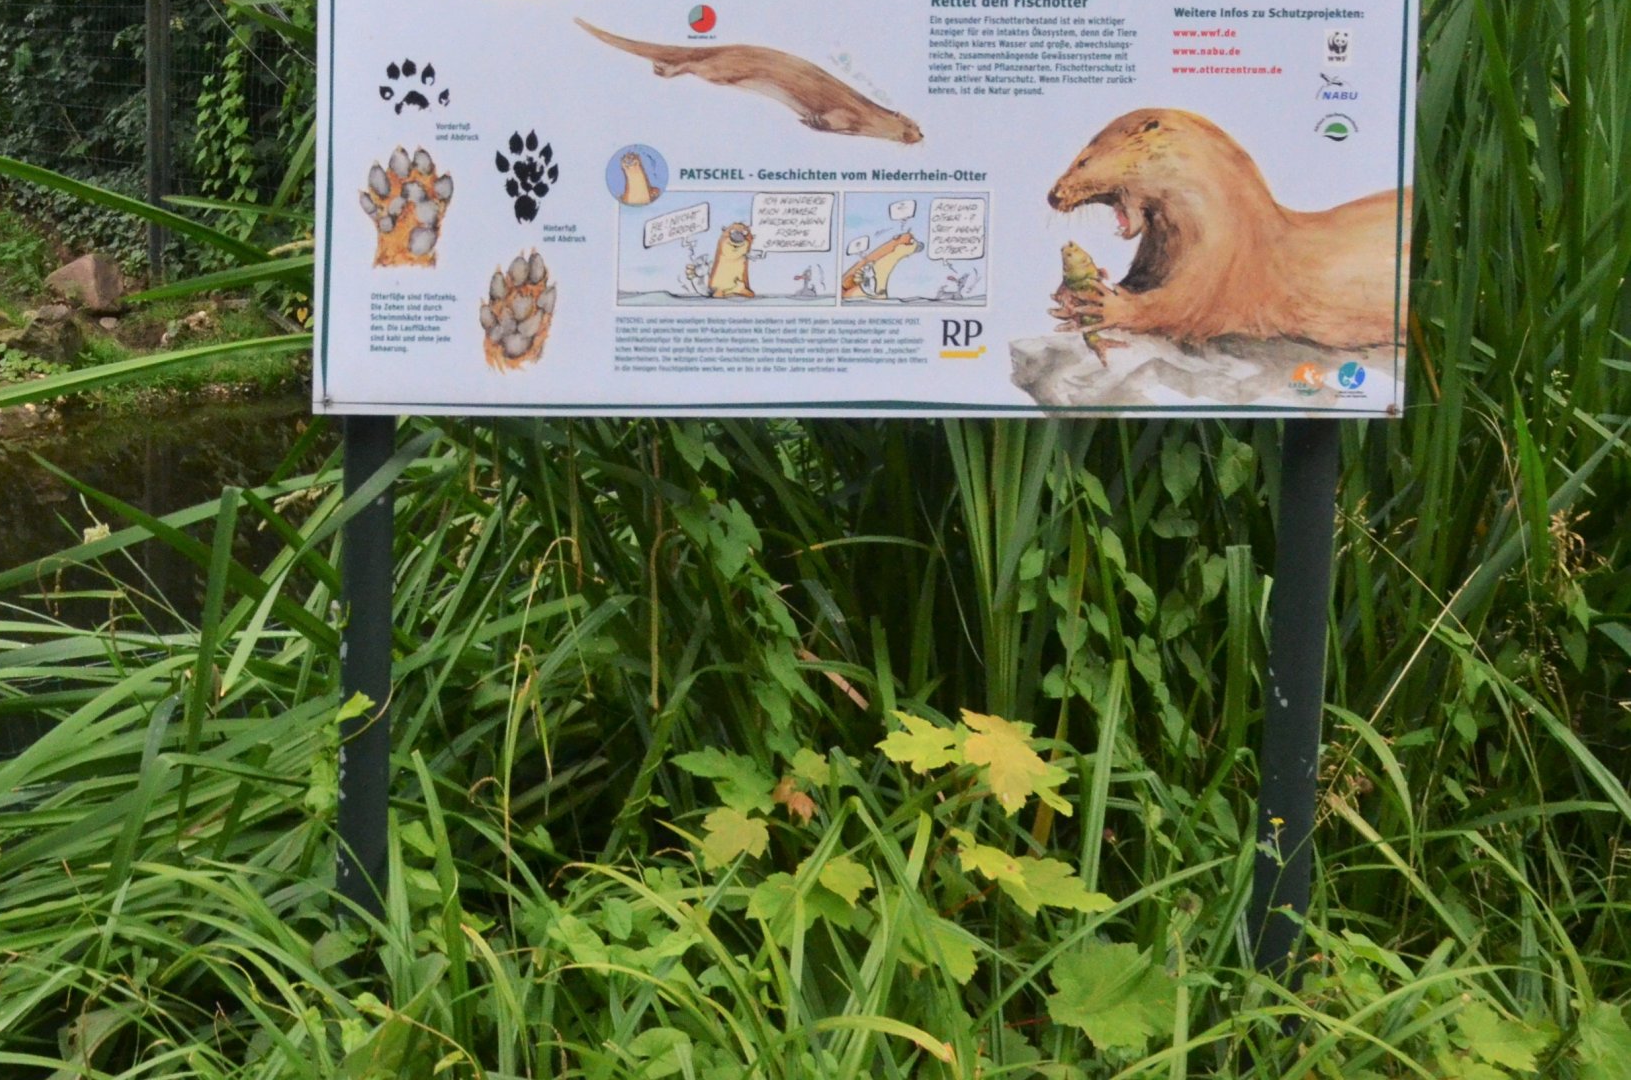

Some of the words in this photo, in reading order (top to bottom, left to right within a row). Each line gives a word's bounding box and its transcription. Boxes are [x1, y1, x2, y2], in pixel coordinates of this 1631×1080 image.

[1174, 7, 1217, 18] Weitere
[1220, 8, 1249, 18] Infos
[1252, 10, 1265, 18] zu
[1268, 8, 1365, 20] Schutzprojekten:
[1173, 29, 1236, 37] www.wwf.de
[1172, 47, 1241, 56] www.nabu.de
[1172, 66, 1282, 74] www.otterzentrum.de
[1322, 91, 1358, 100] NABU
[680, 168, 743, 180] PATSCHEL
[758, 168, 837, 180] Geschichten
[841, 171, 867, 181] vom
[872, 169, 987, 181] Niederrhein-Otter
[941, 319, 983, 347] RP
